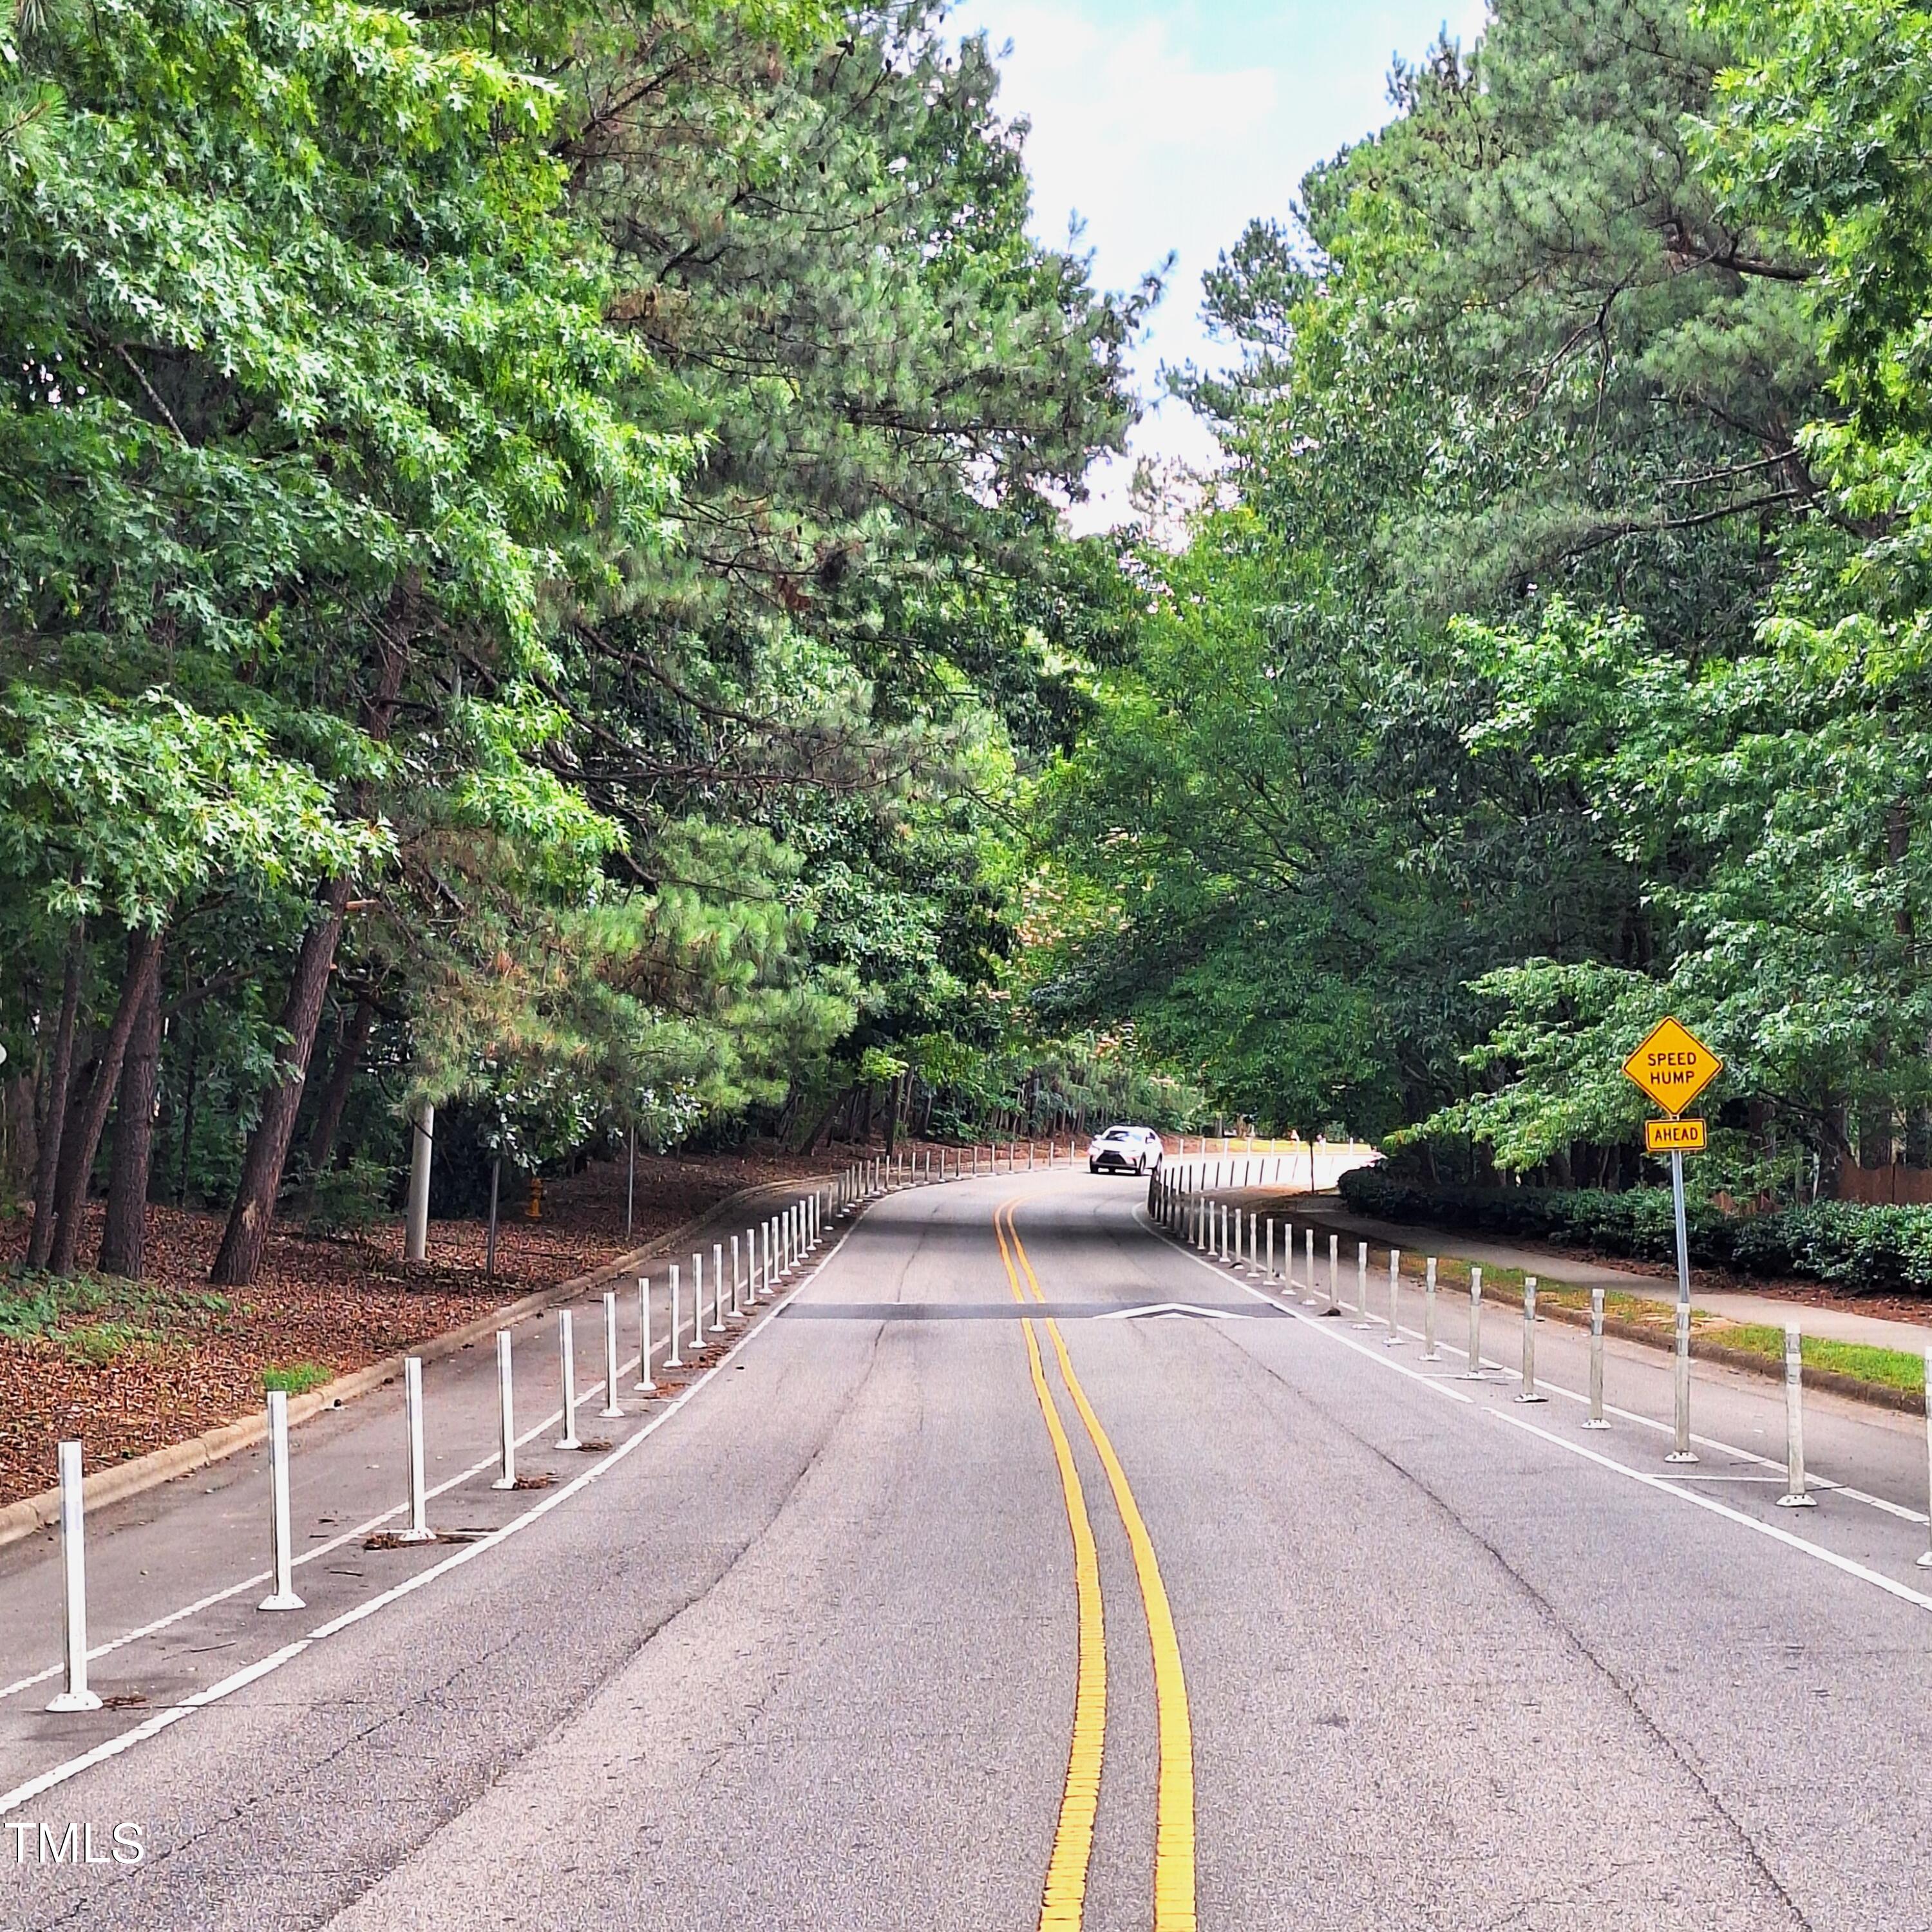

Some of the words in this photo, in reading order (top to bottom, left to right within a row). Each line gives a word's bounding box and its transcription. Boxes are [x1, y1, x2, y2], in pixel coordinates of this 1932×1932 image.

[1647, 1052, 1697, 1066] SPEED
[1651, 1070, 1695, 1084] HUMP
[1654, 1127, 1698, 1142] AHEAD
